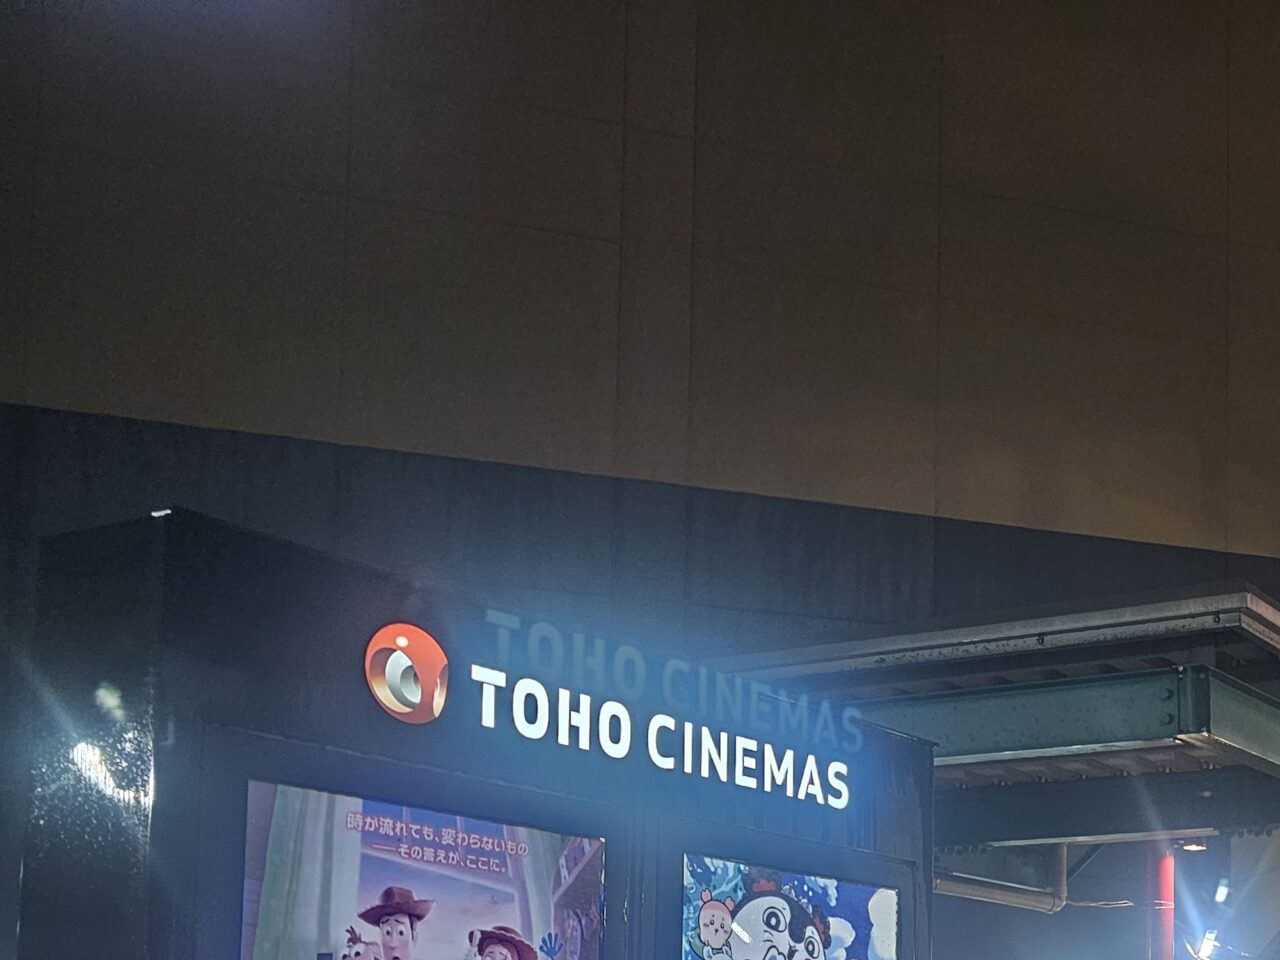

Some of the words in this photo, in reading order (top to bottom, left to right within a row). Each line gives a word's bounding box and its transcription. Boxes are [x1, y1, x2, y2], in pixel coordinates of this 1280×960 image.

[470, 663, 632, 759] TOHO
[647, 713, 851, 810] CINEMAS
[347, 813, 529, 856] 時が流れても、変わらないもの
